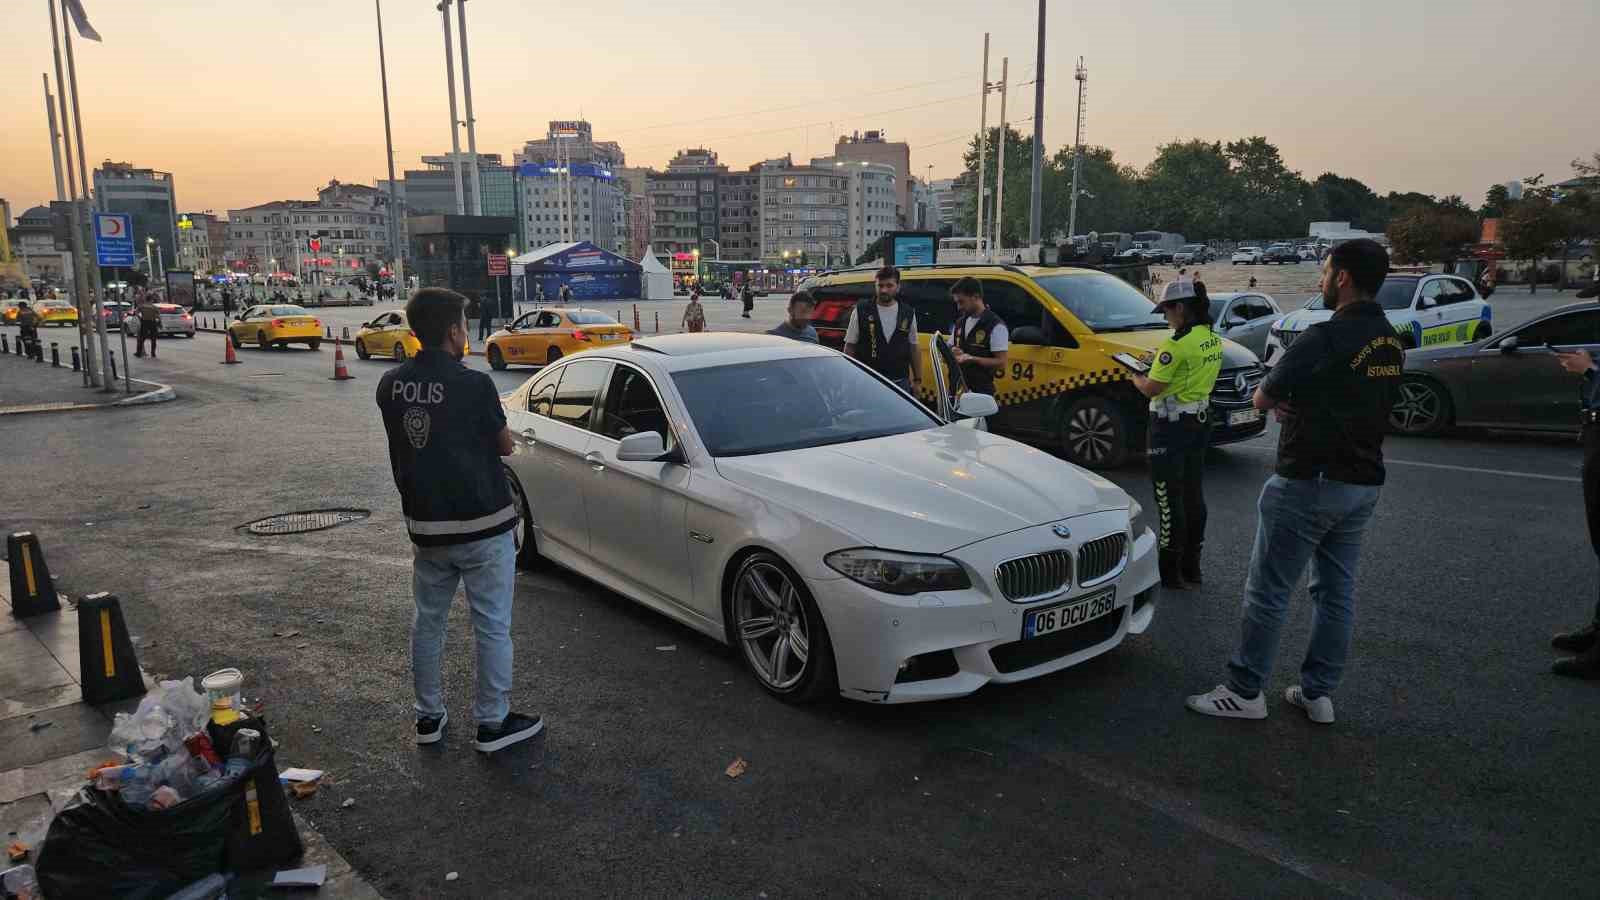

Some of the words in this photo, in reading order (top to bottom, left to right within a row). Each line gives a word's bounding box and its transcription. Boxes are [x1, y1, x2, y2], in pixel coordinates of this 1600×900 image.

[1012, 361, 1034, 382] 94
[1036, 610, 1055, 633] 06
[1061, 603, 1089, 627] DCU
